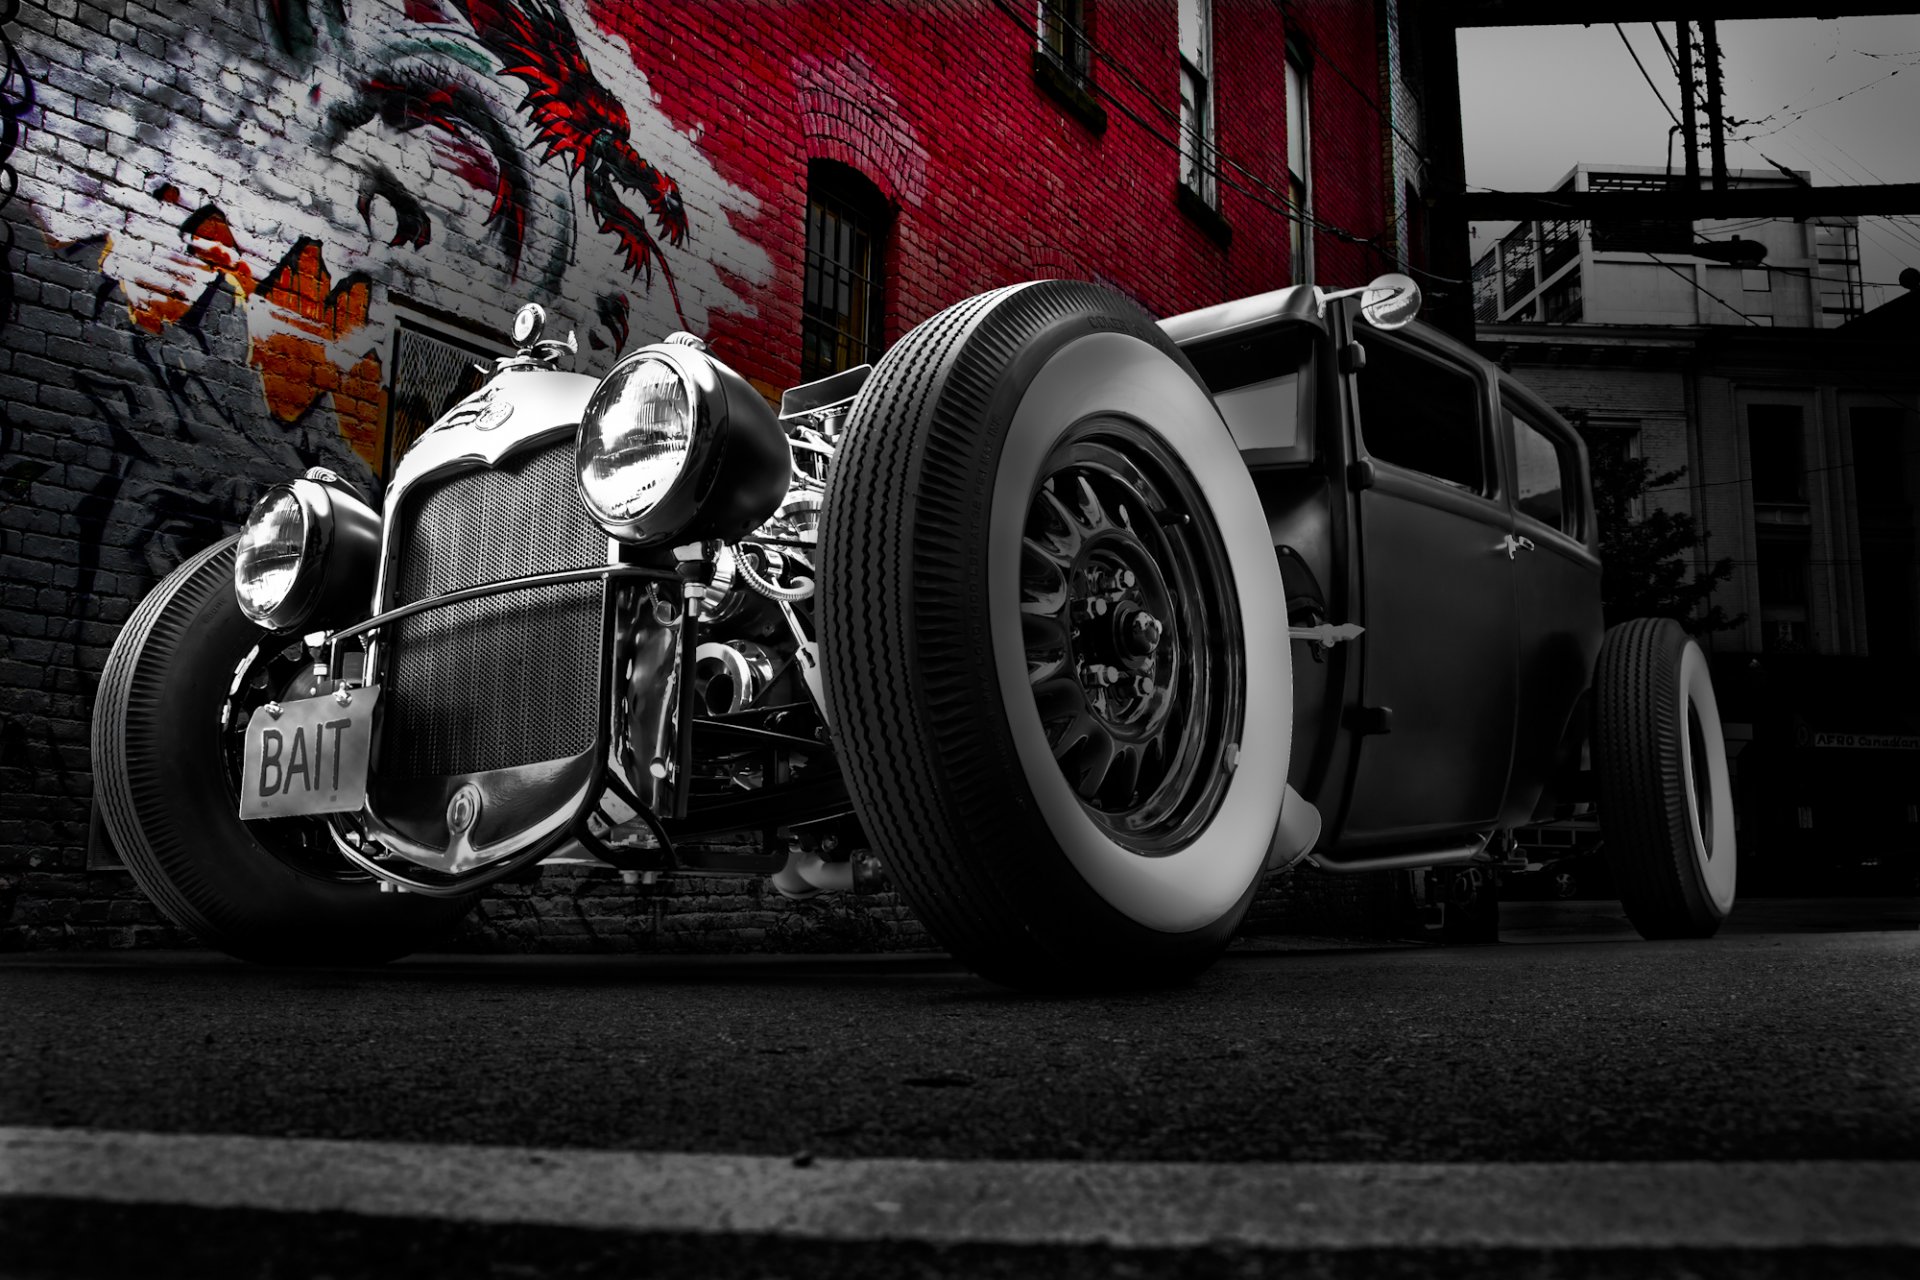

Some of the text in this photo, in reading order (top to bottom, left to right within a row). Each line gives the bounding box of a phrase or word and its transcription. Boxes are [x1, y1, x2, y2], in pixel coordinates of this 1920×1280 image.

[259, 718, 352, 797] BAIT
[1817, 734, 1919, 748] AFRO Canadian
